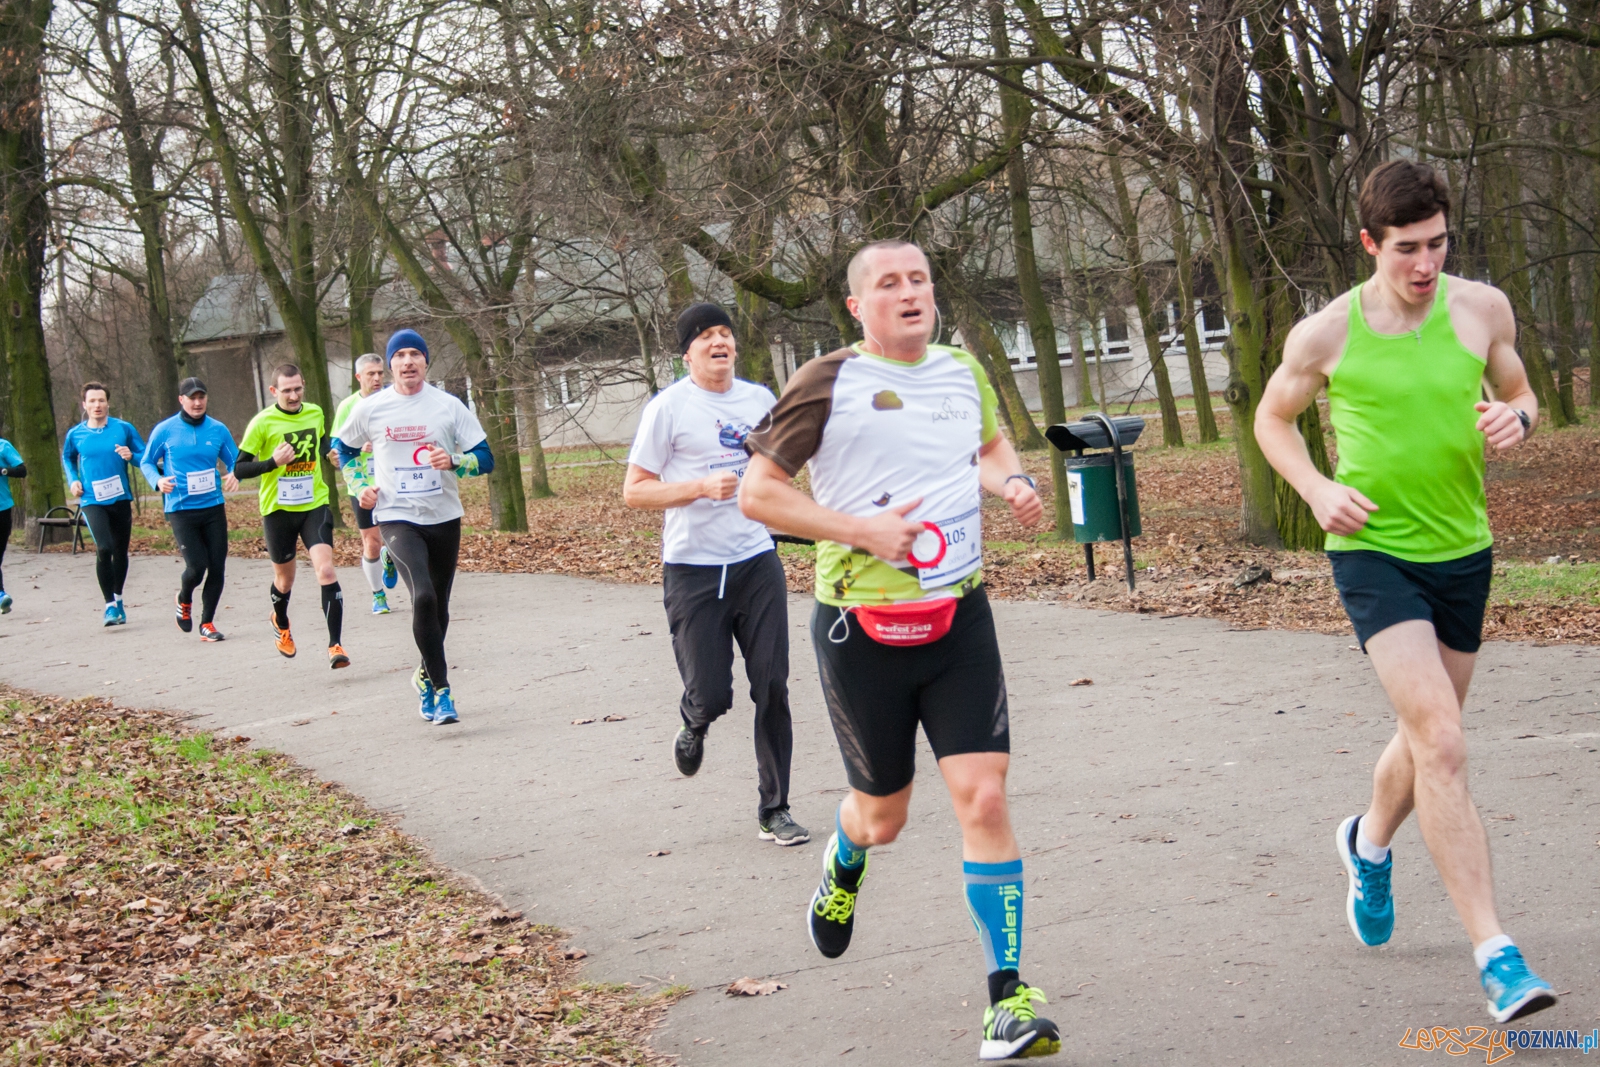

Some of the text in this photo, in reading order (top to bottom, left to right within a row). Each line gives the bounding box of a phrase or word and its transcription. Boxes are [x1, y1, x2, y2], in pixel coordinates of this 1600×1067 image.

[103, 483, 113, 491] 577
[290, 483, 303, 491] 546
[945, 526, 966, 547] 105
